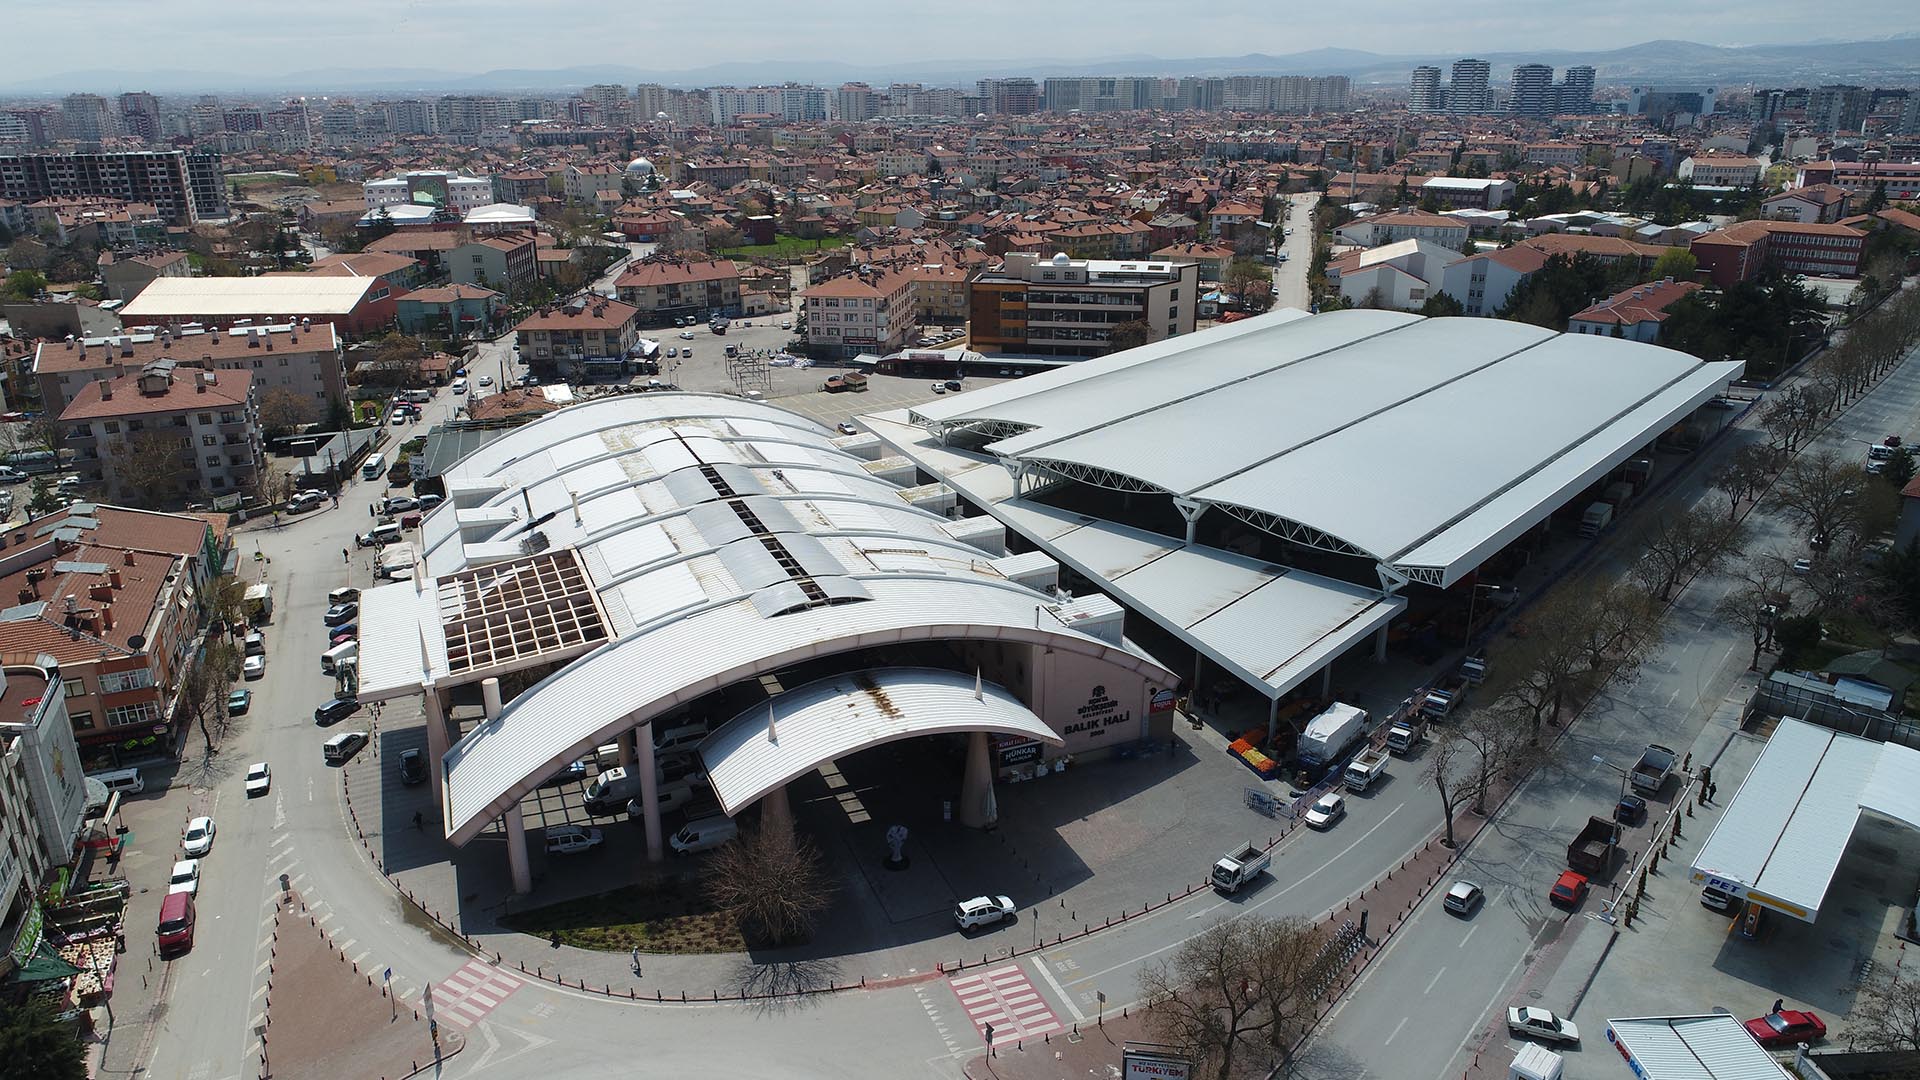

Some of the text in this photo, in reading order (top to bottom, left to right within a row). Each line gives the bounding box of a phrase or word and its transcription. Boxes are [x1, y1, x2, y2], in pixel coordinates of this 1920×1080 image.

[1064, 710, 1130, 735] BALIK HALİ
[1709, 878, 1741, 893] PET
